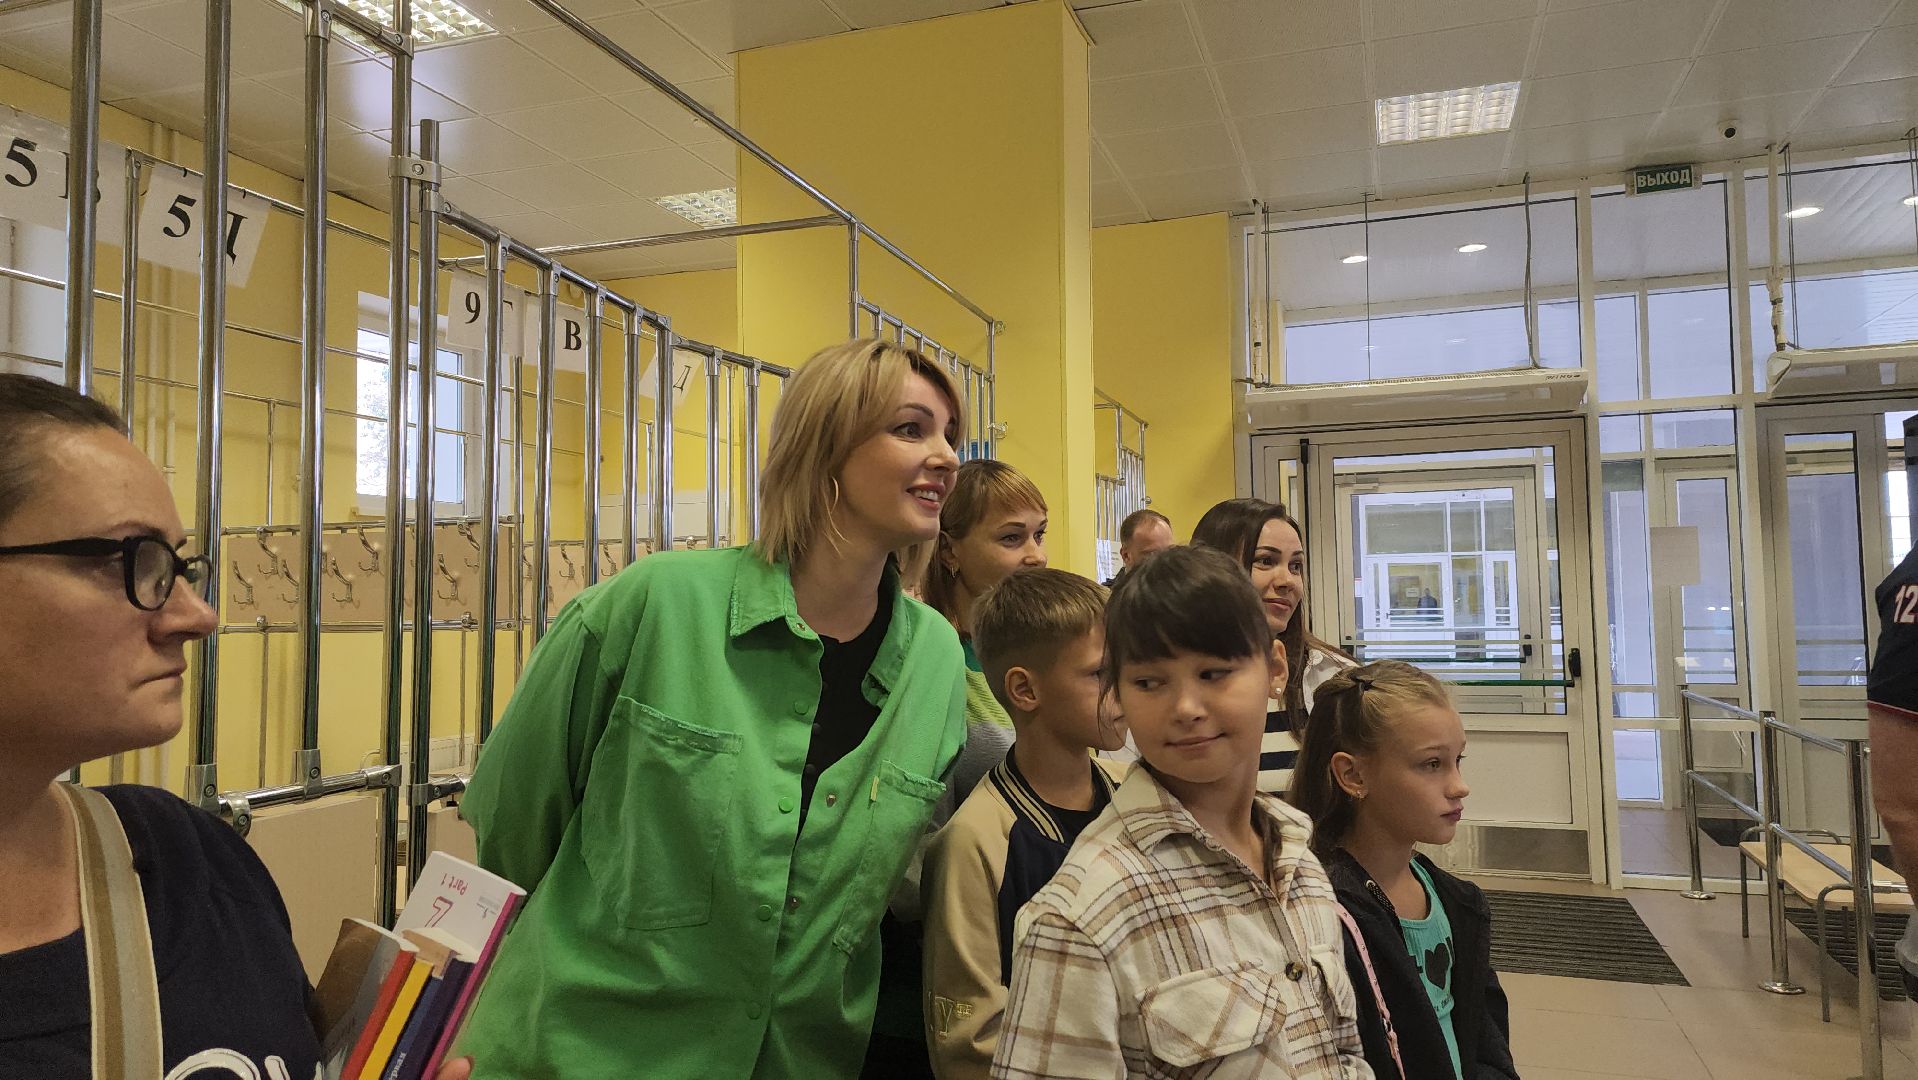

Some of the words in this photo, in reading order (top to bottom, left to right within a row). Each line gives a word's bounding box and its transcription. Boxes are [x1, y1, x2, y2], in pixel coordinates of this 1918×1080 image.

[4, 136, 38, 188] 5
[1637, 169, 1691, 188] ВЫХОД
[163, 194, 197, 238] 5
[465, 291, 481, 325] 9
[563, 318, 582, 351] В
[1893, 584, 1918, 624] 12
[440, 872, 448, 886] 1
[448, 875, 469, 896] Part
